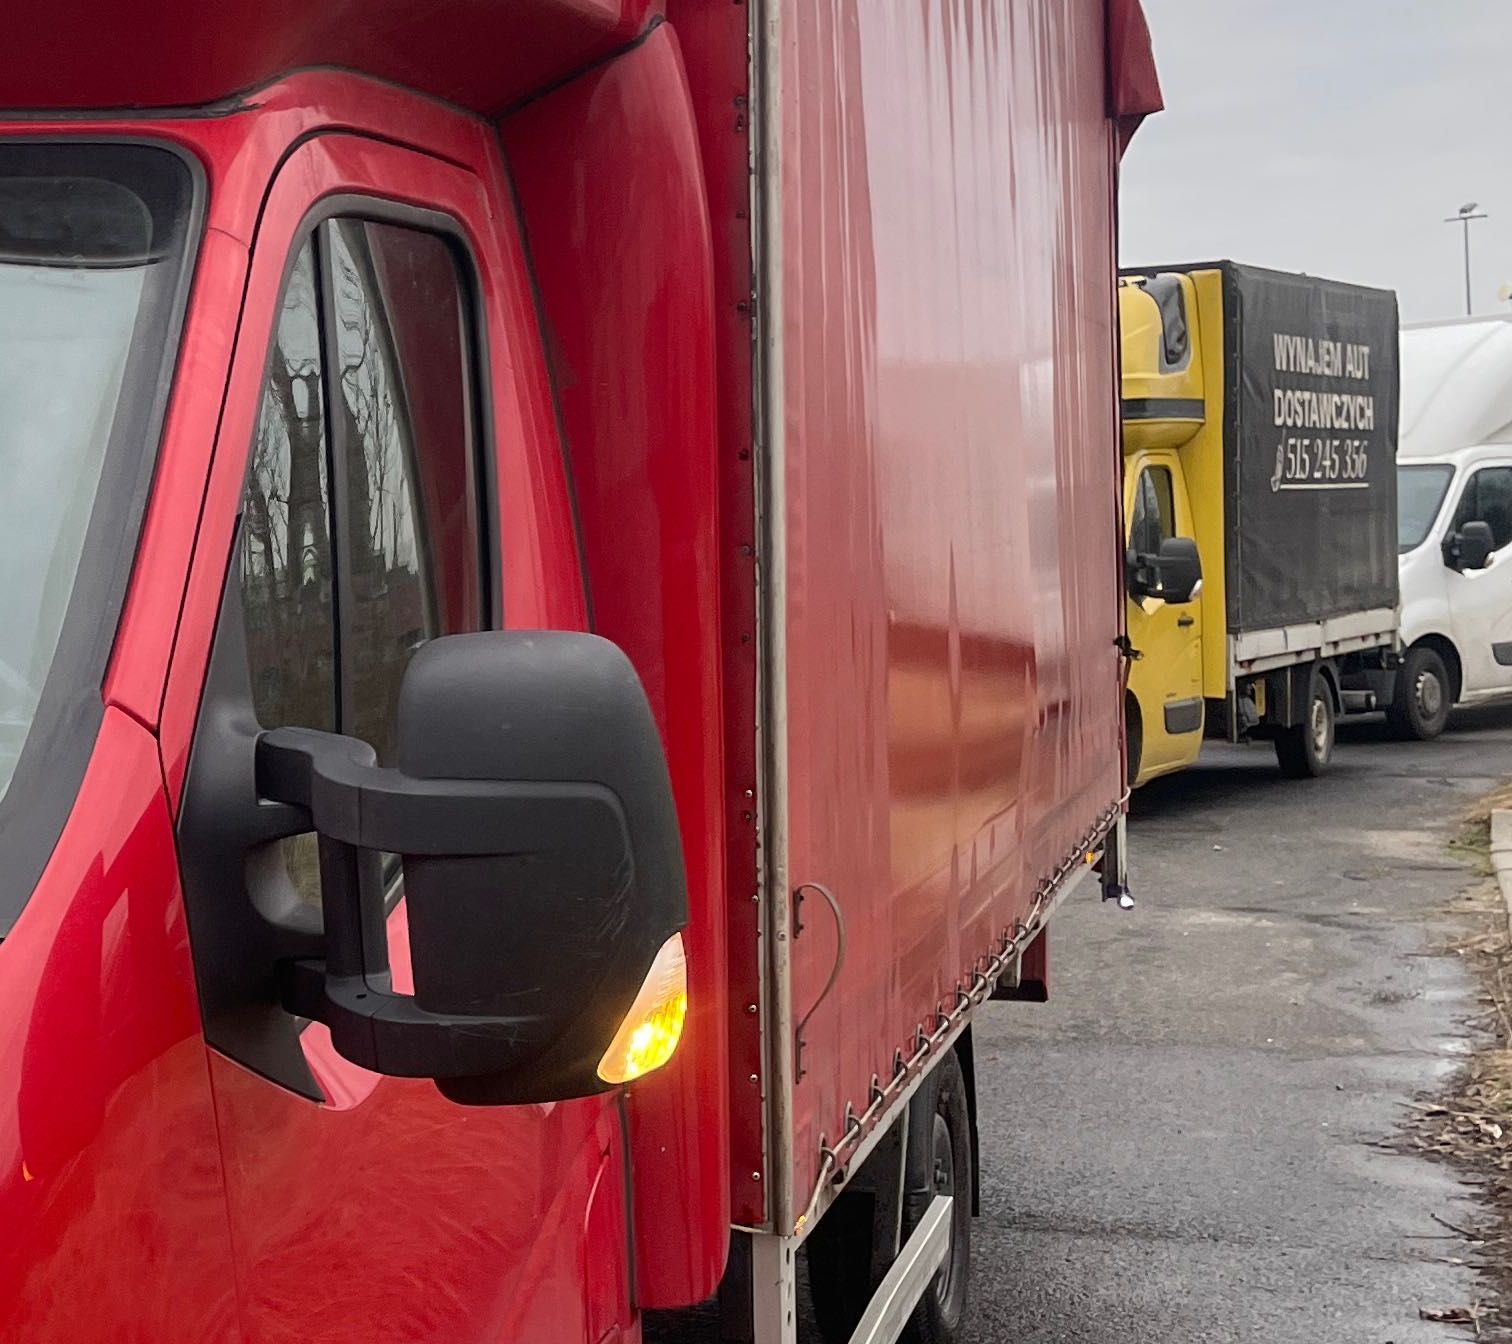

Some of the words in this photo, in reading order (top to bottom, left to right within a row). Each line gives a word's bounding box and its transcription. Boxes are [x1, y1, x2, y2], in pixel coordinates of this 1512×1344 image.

[1273, 333, 1343, 378] WYNAJEM
[1345, 343, 1370, 380] AUT
[1273, 388, 1374, 431] DOSTAWCZYCH
[1286, 437, 1310, 479] 515
[1313, 438, 1340, 480] 245
[1342, 438, 1369, 479] 356
